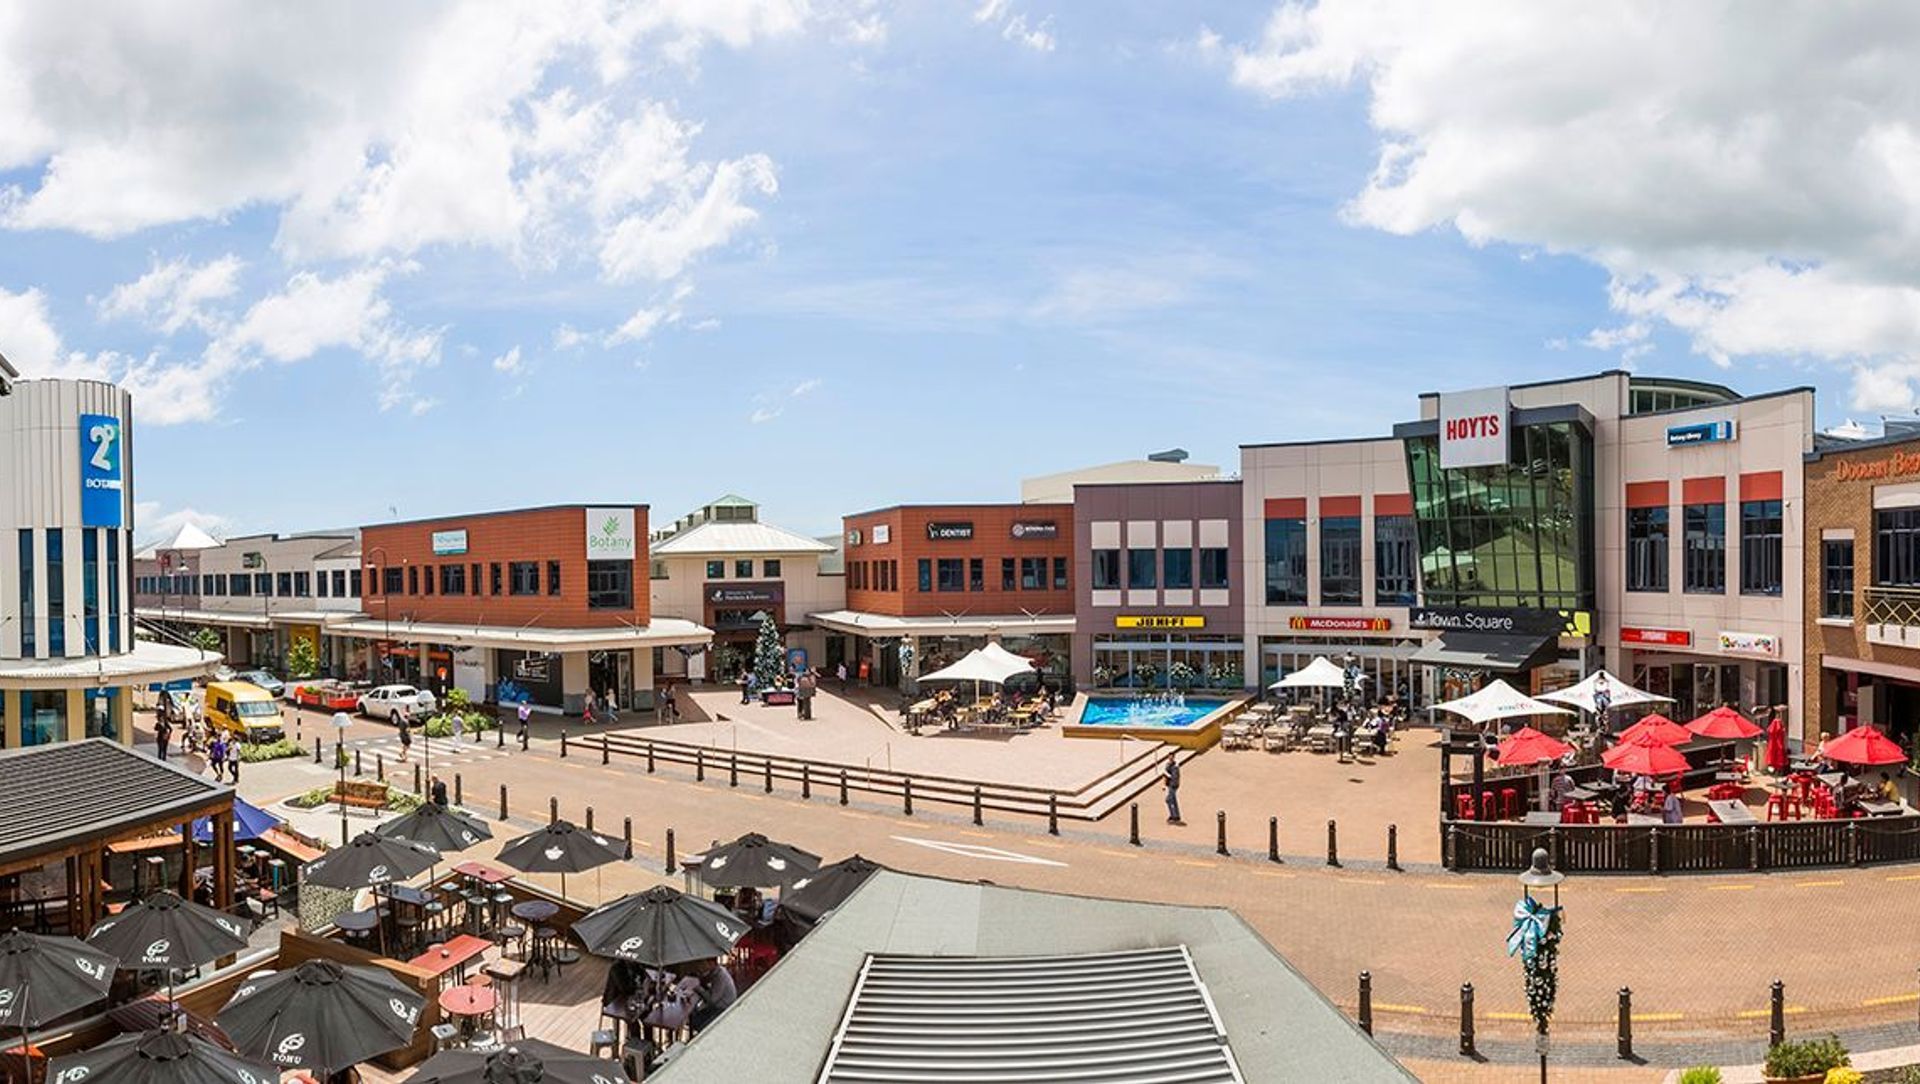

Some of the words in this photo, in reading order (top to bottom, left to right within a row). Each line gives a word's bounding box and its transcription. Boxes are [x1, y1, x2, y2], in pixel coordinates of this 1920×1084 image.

[1446, 414, 1499, 440] HOYTS
[940, 528, 971, 537] DENTIST
[590, 535, 632, 551] Botany
[1310, 619, 1368, 629] McDonald's
[1427, 612, 1461, 627] Town
[1464, 613, 1513, 630] Square
[271, 1052, 302, 1065] TOHU
